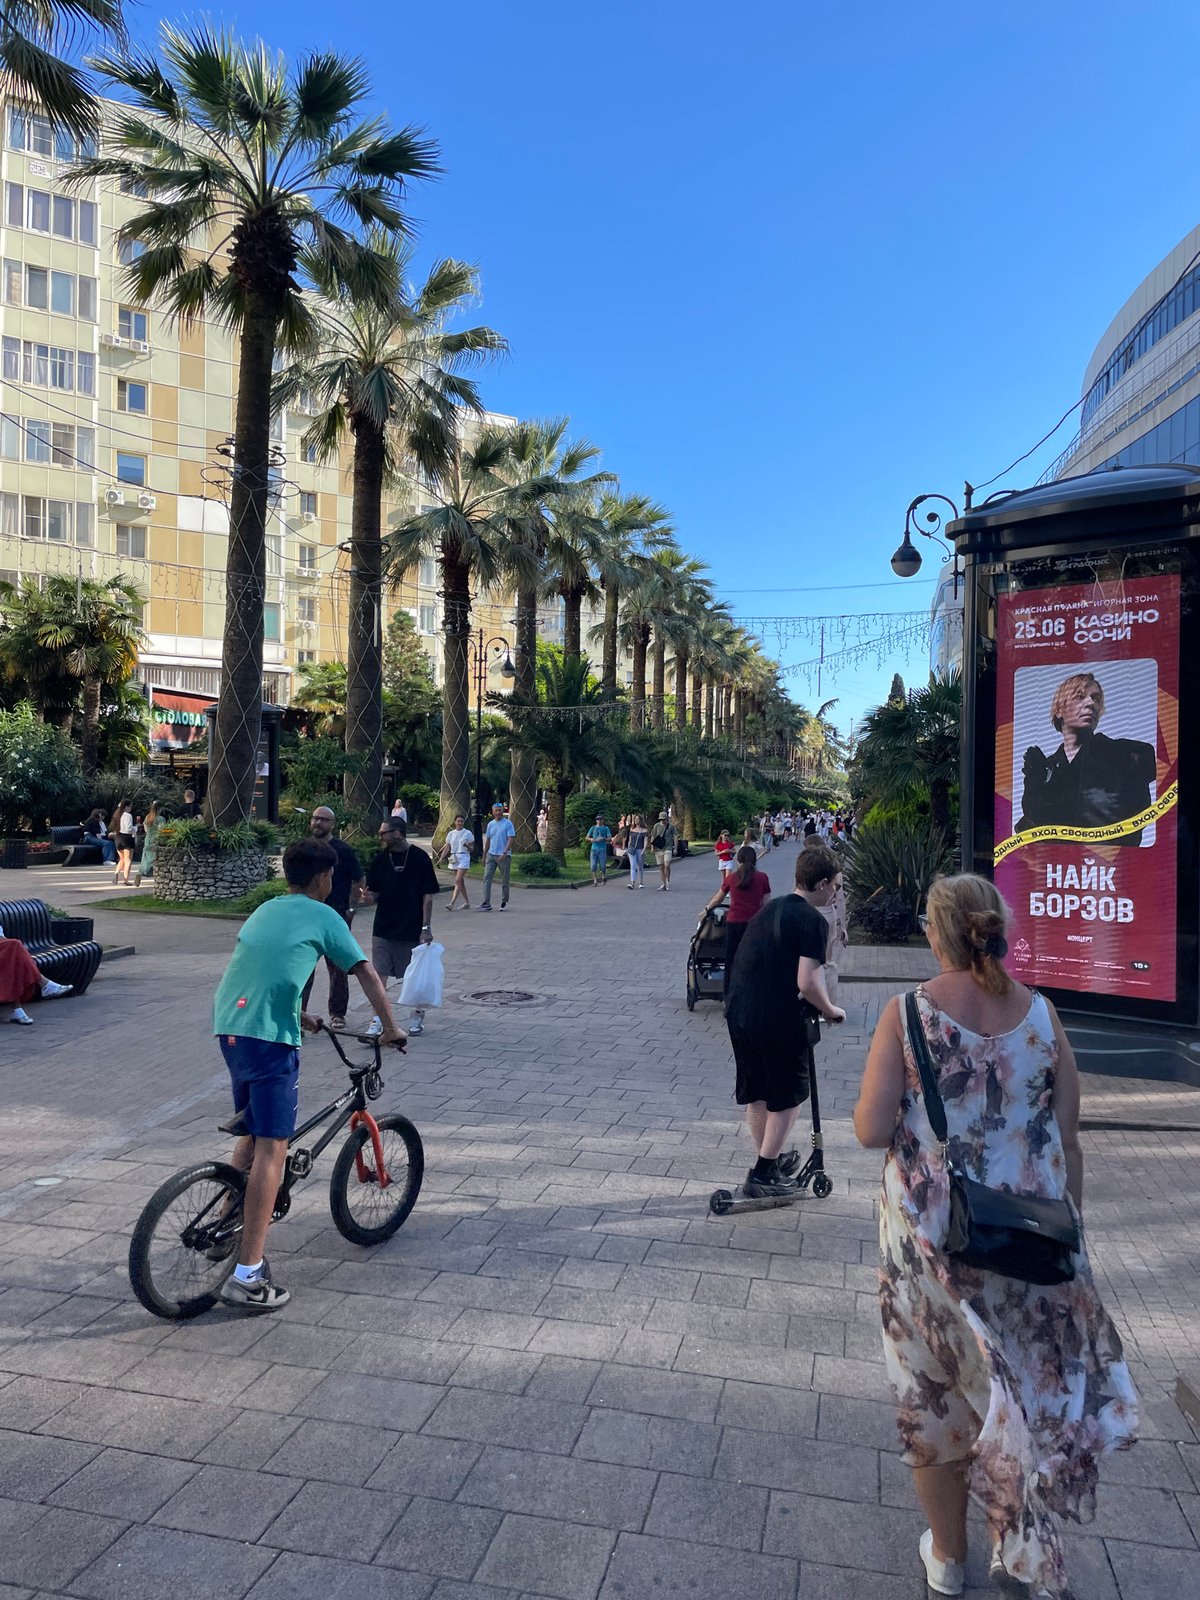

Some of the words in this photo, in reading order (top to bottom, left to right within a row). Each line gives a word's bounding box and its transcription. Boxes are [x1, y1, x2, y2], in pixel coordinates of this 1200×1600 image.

[1015, 605, 1052, 615] КРАСНАЯ
[1053, 601, 1089, 611] ПОЛЯНА
[1093, 597, 1133, 607] ИГОРНАЯ
[1135, 594, 1159, 603] ЗОНА
[1014, 618, 1066, 640] 25.06
[1074, 609, 1159, 630] КАЗИНО
[1073, 626, 1132, 644] СОЧИ
[154, 709, 207, 727] СТОЛОВАЯ
[1031, 828, 1058, 838] ВХОД
[1060, 825, 1124, 838] СВОБОДНЫЙ
[1132, 809, 1159, 827] ВХОД
[1046, 858, 1117, 892] НАЙК
[1029, 892, 1134, 923] БОРЗОВ
[1067, 934, 1094, 944] КОНЦЕРТ
